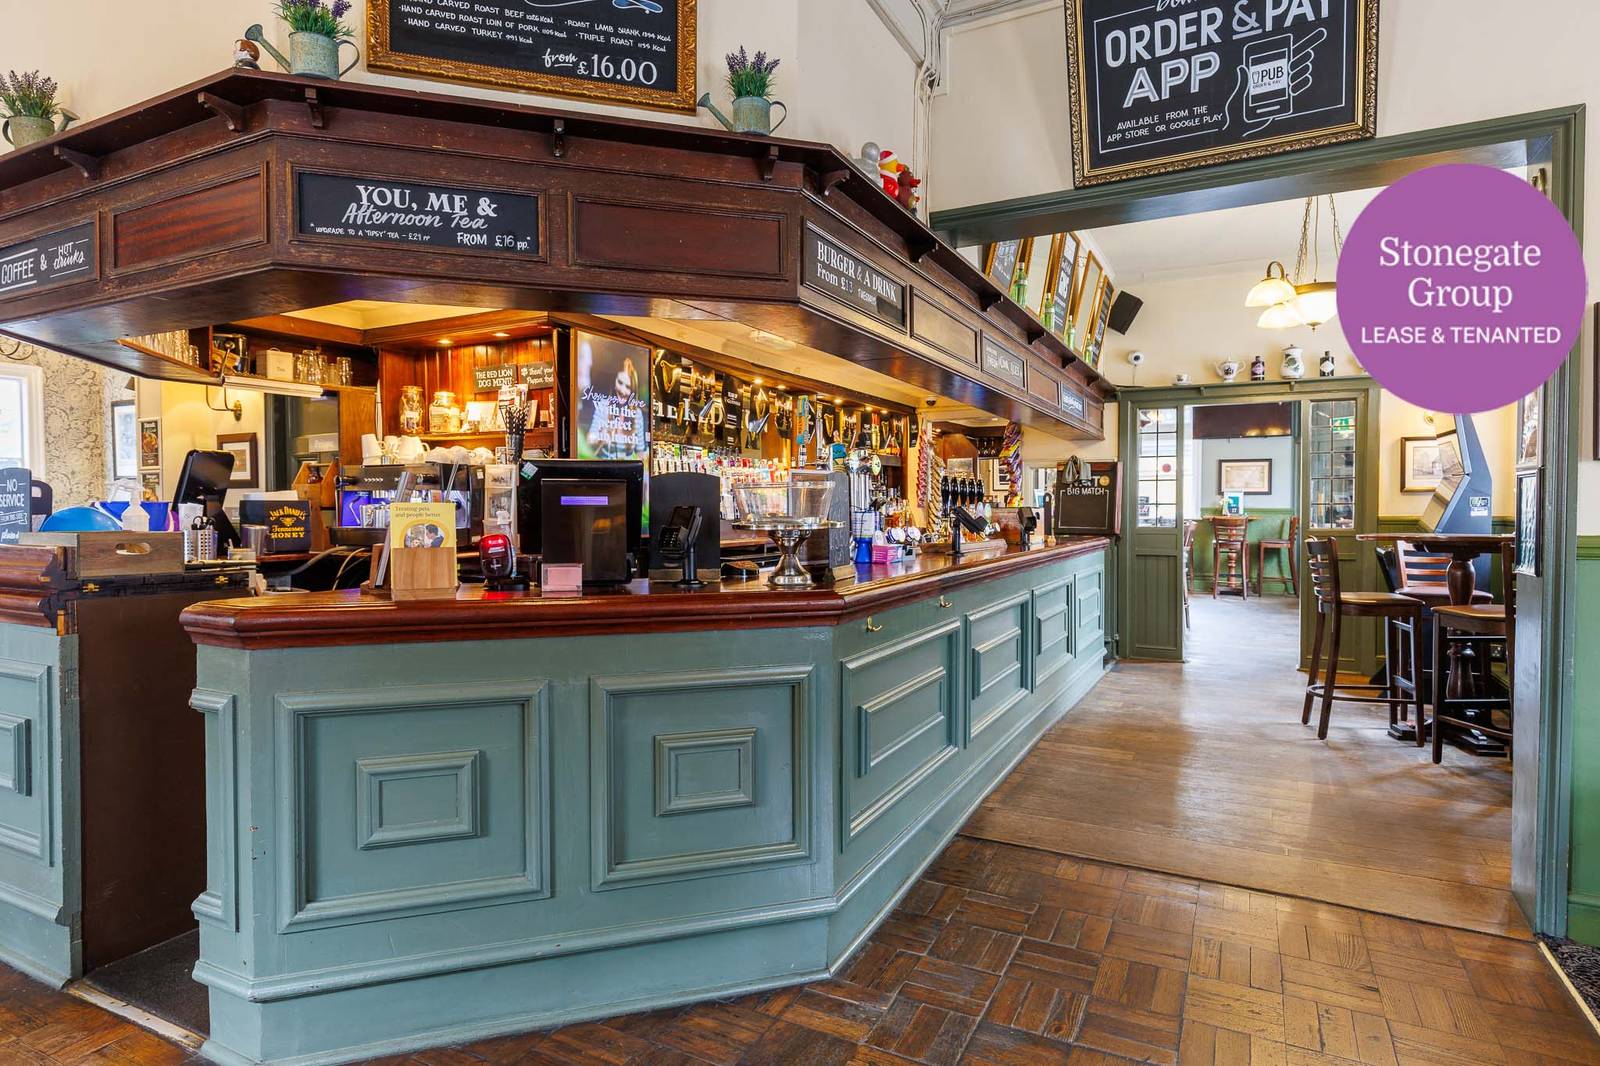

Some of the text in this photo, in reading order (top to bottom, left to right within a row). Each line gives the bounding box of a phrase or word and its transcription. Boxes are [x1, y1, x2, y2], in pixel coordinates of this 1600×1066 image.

[401, 5, 423, 14] HAND
[425, 9, 456, 20] CARVED
[459, 14, 483, 25] ROAST
[486, 18, 502, 28] LOIN
[505, 21, 515, 29] OF
[518, 23, 540, 33] PORK
[474, 4, 500, 14] ROAST
[504, 9, 525, 18] BEEF
[407, 17, 430, 28] HAND
[434, 22, 466, 33] CARVED
[471, 27, 503, 40] TURKEY
[567, 20, 590, 28] ROAST
[594, 23, 614, 32] LAMB
[617, 27, 641, 37] SHANK
[1104, 7, 1224, 69] ORDER
[1232, 0, 1261, 32] &
[579, 32, 606, 43] TRIPLE
[610, 36, 634, 47] ROAST
[542, 48, 658, 85] from £16.00
[1261, 66, 1284, 82] PUB
[1122, 51, 1221, 109] APP
[1107, 113, 1223, 143] APP STORE OR GOOGLE PLAY
[1117, 105, 1208, 131] AVAILABLE FROM THE
[356, 185, 498, 217] YOU, ME &
[342, 202, 488, 229] Afternoon Tea
[347, 228, 356, 236] TO
[457, 232, 487, 246] FROM
[495, 234, 515, 248] £16
[58, 241, 74, 256] HOT
[1, 254, 48, 285] COFFEE &
[53, 250, 86, 270] drinks
[817, 240, 897, 302] BURGER & A DRINK
[817, 262, 838, 287] From
[476, 368, 513, 380] THE RED LION
[478, 379, 491, 388] DOG
[581, 385, 607, 400] Show
[628, 392, 646, 407] love
[620, 404, 636, 417] the
[7, 479, 17, 492] NO
[1067, 487, 1105, 496] BIG MATCH
